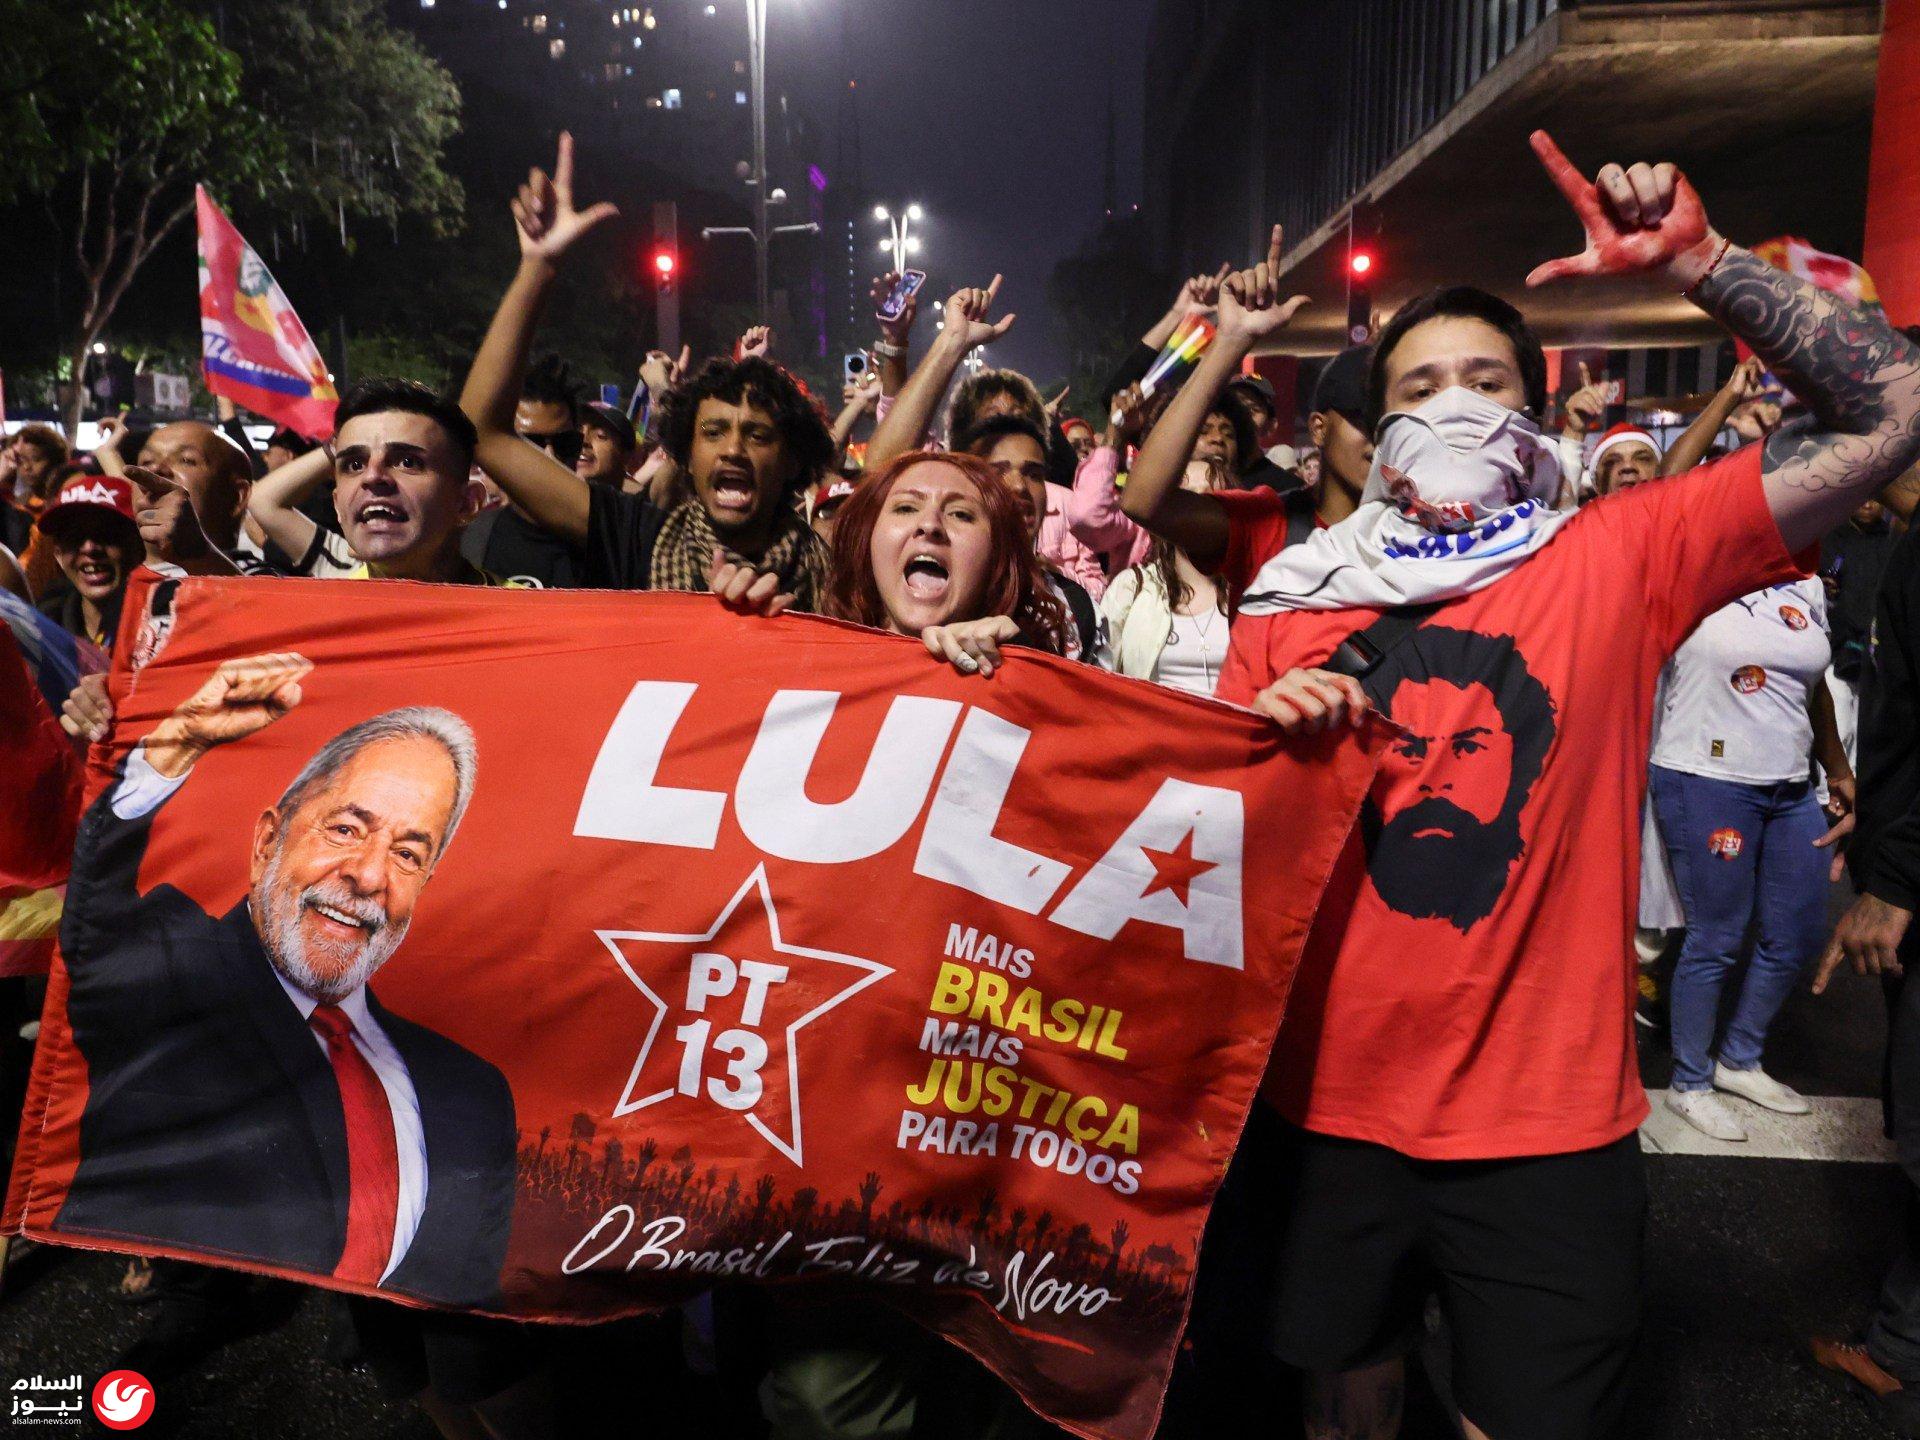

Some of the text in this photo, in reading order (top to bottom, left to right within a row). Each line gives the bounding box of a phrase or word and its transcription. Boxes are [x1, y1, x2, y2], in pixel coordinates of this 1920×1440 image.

[572, 680, 1245, 971] LULA
[685, 953, 789, 1026] PT
[944, 923, 1035, 978] MAIS
[919, 1017, 1023, 1066] MAIS
[930, 961, 1128, 1060] BRASIL
[676, 1018, 768, 1110] 13
[906, 1058, 1139, 1154] JUSTIÇA
[897, 1110, 1142, 1194] PARA TODOS
[561, 1204, 635, 1275] O
[625, 1216, 793, 1277] Brasil
[996, 1250, 1122, 1320] Novo
